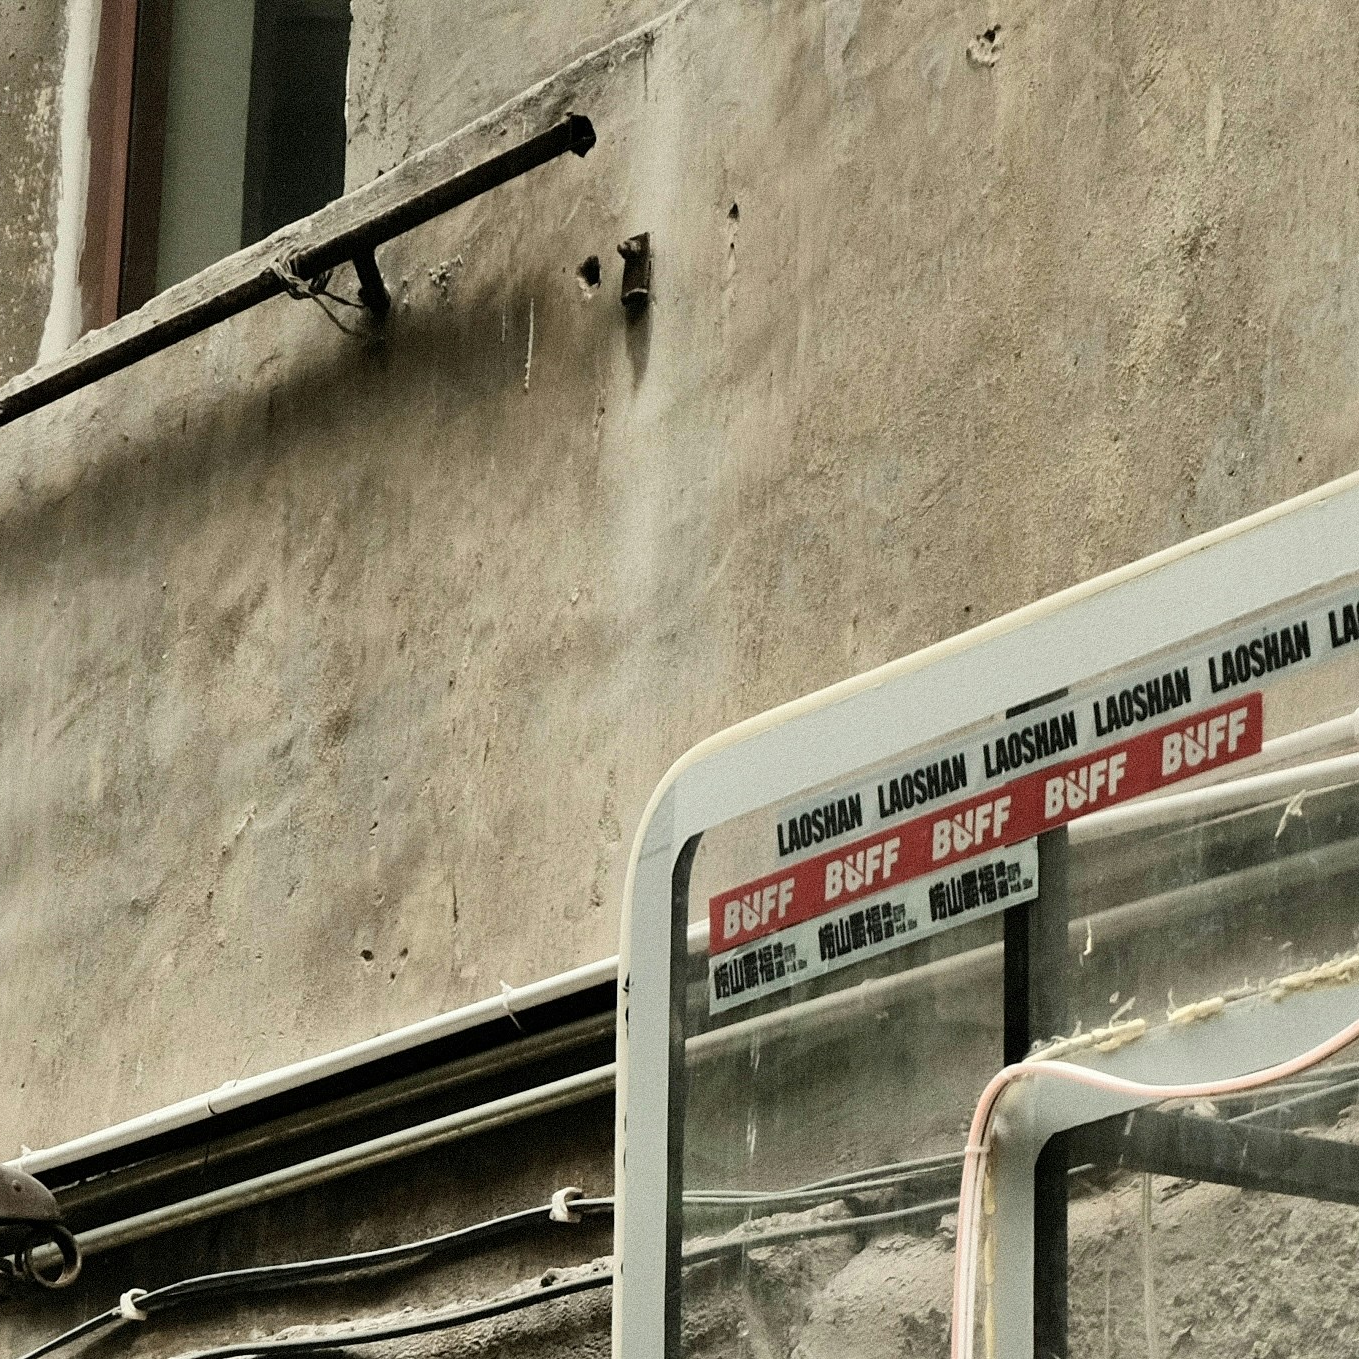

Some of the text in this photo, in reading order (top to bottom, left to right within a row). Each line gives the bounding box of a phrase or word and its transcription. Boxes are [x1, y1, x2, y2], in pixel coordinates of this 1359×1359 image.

[723, 707, 1249, 938] BUFF BUFF BUFF BUFF BUFF
[776, 793, 863, 856] LAOSHAN
[877, 753, 968, 818] LAOSHAN
[983, 712, 1078, 778] LAOSHAN
[1093, 667, 1192, 736] LAOSHAN
[1209, 622, 1311, 693] LAOSHAN
